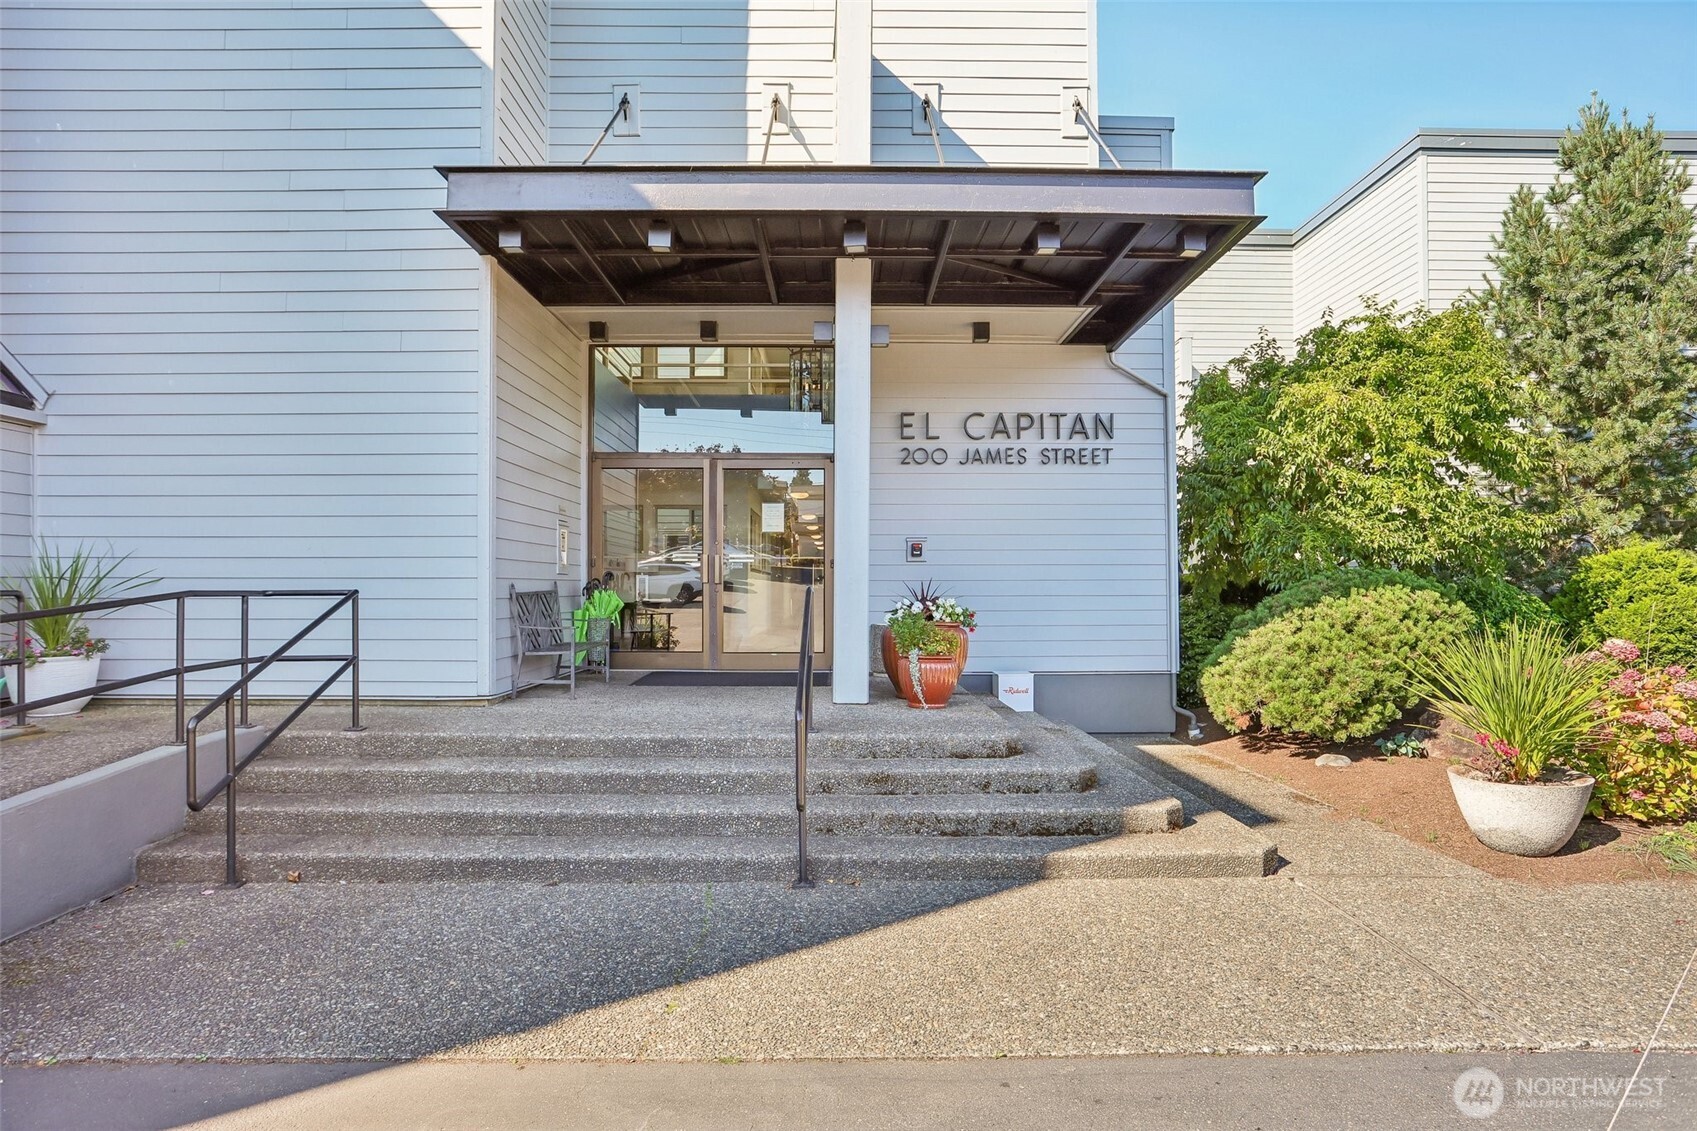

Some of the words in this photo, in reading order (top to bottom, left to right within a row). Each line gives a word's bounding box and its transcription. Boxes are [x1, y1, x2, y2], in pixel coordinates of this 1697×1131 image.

[900, 412, 940, 440] EL
[963, 412, 1115, 440] CAPITAN
[900, 447, 948, 465] 200
[959, 447, 1027, 465] JAMES
[1040, 447, 1113, 465] STREET
